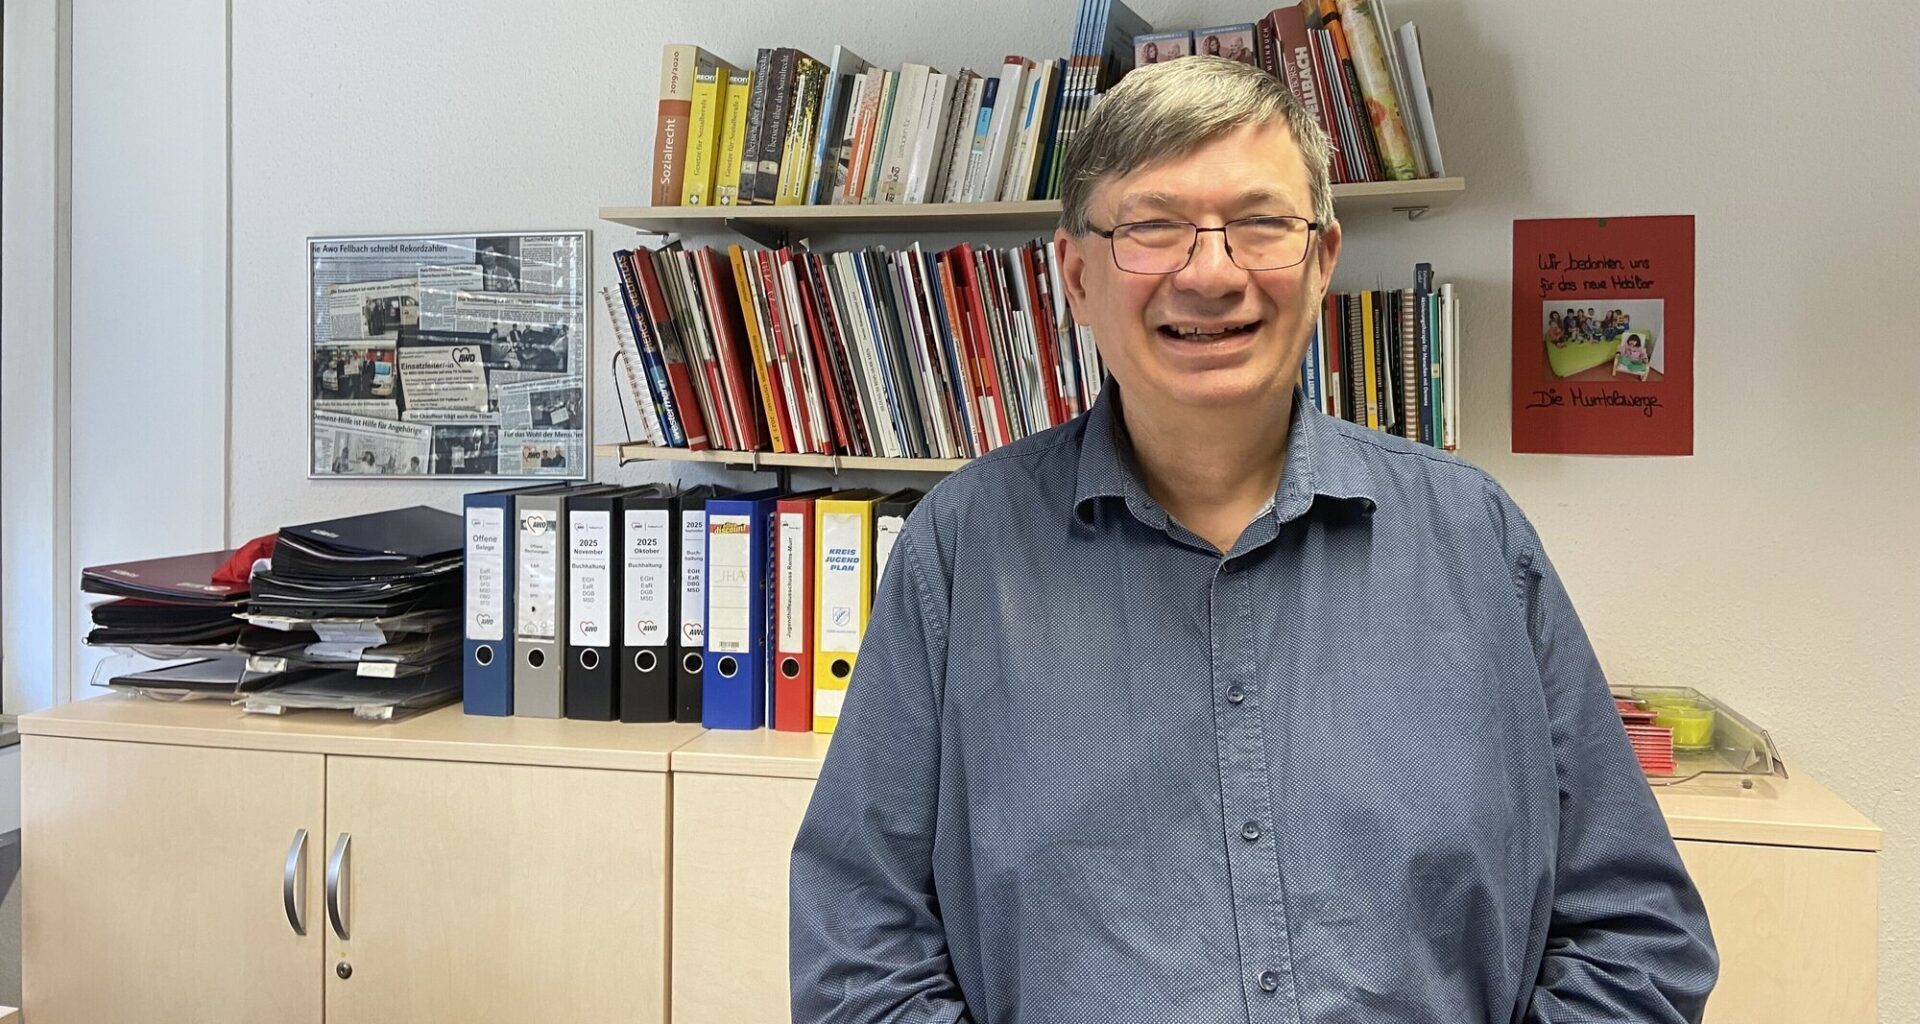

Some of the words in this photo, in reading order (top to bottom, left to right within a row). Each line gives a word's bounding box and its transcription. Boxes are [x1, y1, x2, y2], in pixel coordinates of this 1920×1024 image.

[1263, 27, 1272, 71] WEINBUCH
[671, 51, 679, 94] 2019/2020
[753, 54, 769, 95] Arbeitsrecht
[776, 53, 790, 90] Sozialrecht
[1288, 61, 1299, 90] BORST
[751, 96, 762, 107] das
[774, 90, 784, 103] das
[695, 98, 708, 138] Sozialberufe
[727, 100, 740, 140] Sozialberufe
[748, 108, 760, 125] über
[772, 103, 782, 119] über
[694, 139, 703, 150] für
[726, 141, 735, 151] für
[743, 125, 758, 157] Übersicht
[766, 120, 780, 153] Übersicht
[661, 118, 676, 184] Sozialrecht
[692, 151, 702, 176] Gesetze
[723, 152, 734, 177] Gesetze
[323, 245, 338, 253] Awo
[340, 244, 369, 253] Fellbach
[370, 244, 398, 253] schreibt
[400, 244, 447, 253] Rekordzahlen
[1539, 253, 1560, 269] Wir
[1564, 252, 1624, 271] bedanken
[1631, 259, 1650, 269] uns
[618, 256, 640, 308] WELTATLAS
[1540, 278, 1554, 298] für
[1558, 277, 1577, 291] das
[1584, 279, 1606, 289] neue
[636, 314, 654, 352] DIERCKE
[1419, 297, 1428, 344] Aktivierungstherapie
[459, 353, 475, 362] AWO
[658, 379, 681, 440] westermann
[1526, 389, 1566, 409] Die
[363, 420, 377, 428] Hilfe
[378, 422, 387, 430] für
[473, 535, 497, 543] Offene
